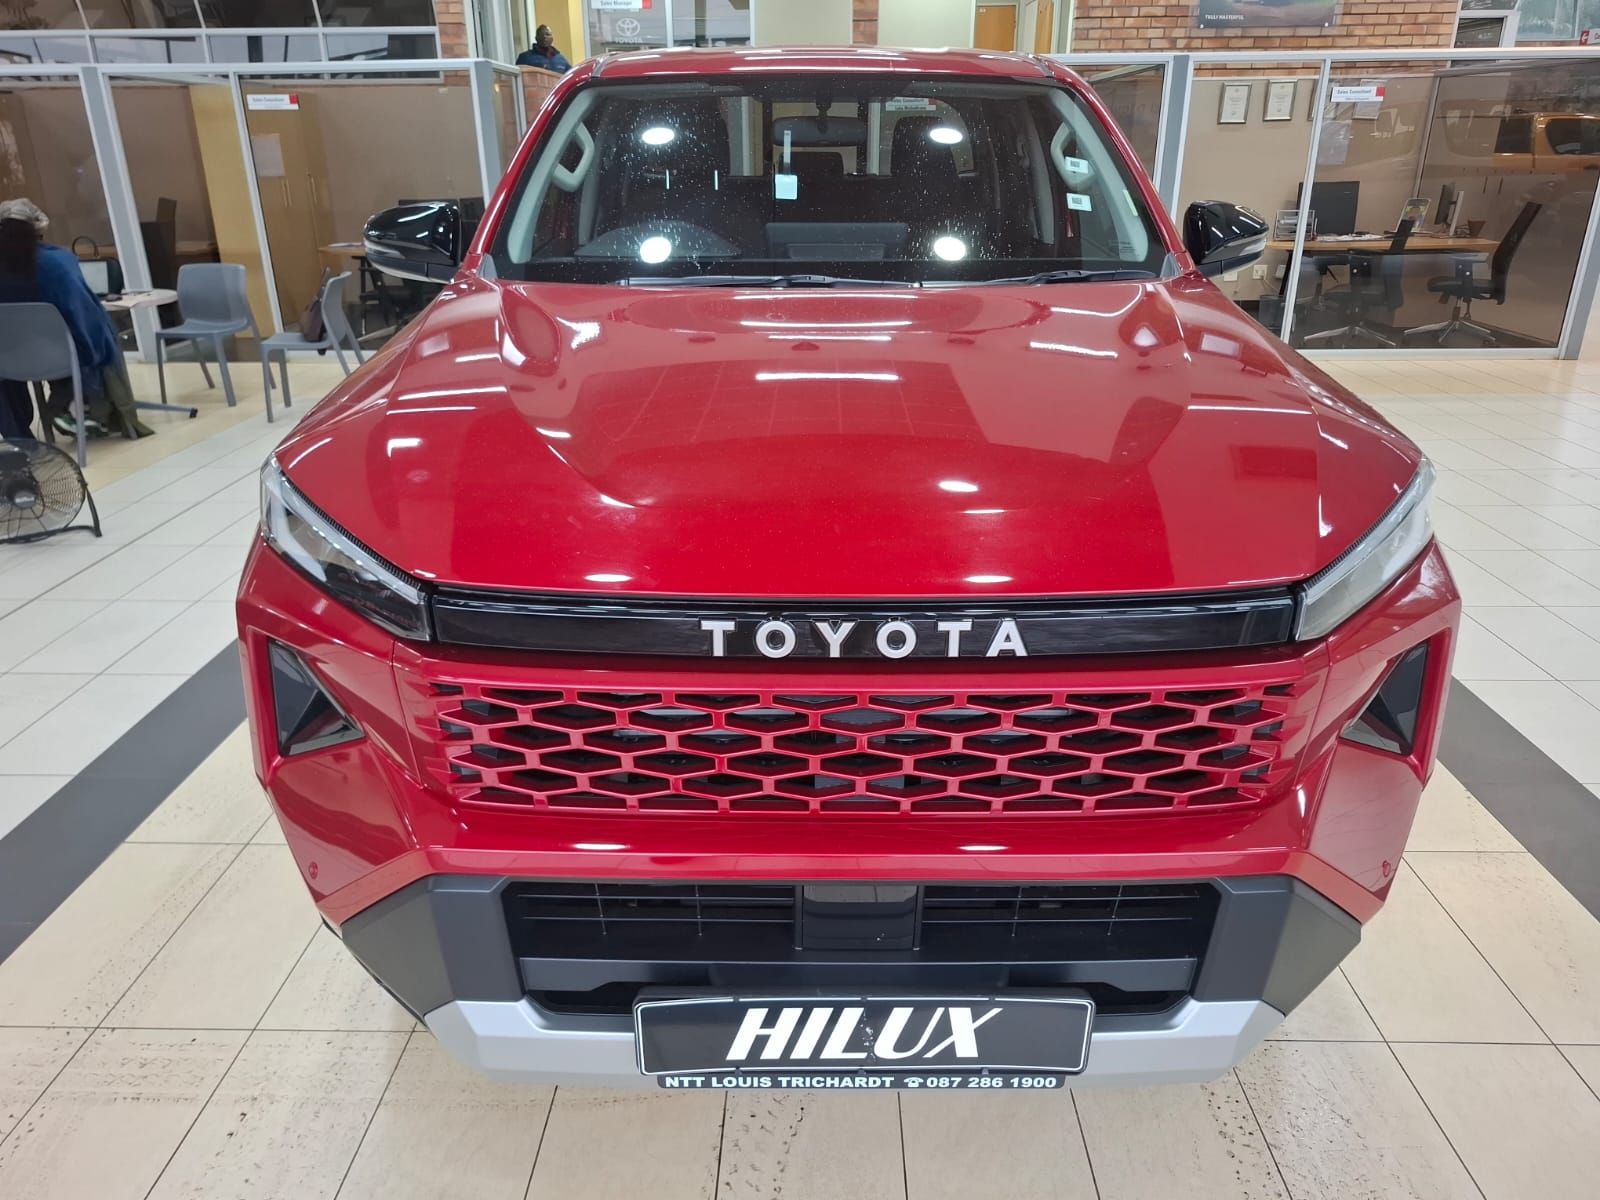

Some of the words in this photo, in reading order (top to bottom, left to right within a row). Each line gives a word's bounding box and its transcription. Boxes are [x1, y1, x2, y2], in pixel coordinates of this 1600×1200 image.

[700, 620, 1029, 659] TOYOTA
[725, 1007, 1004, 1061] HILUX
[664, 1076, 706, 1088] NTT
[711, 1076, 772, 1088] LOUIS
[777, 1076, 895, 1088] TRICHARDT
[926, 1076, 962, 1088] 087
[967, 1076, 1003, 1088] 286
[1009, 1076, 1057, 1088] 1900
